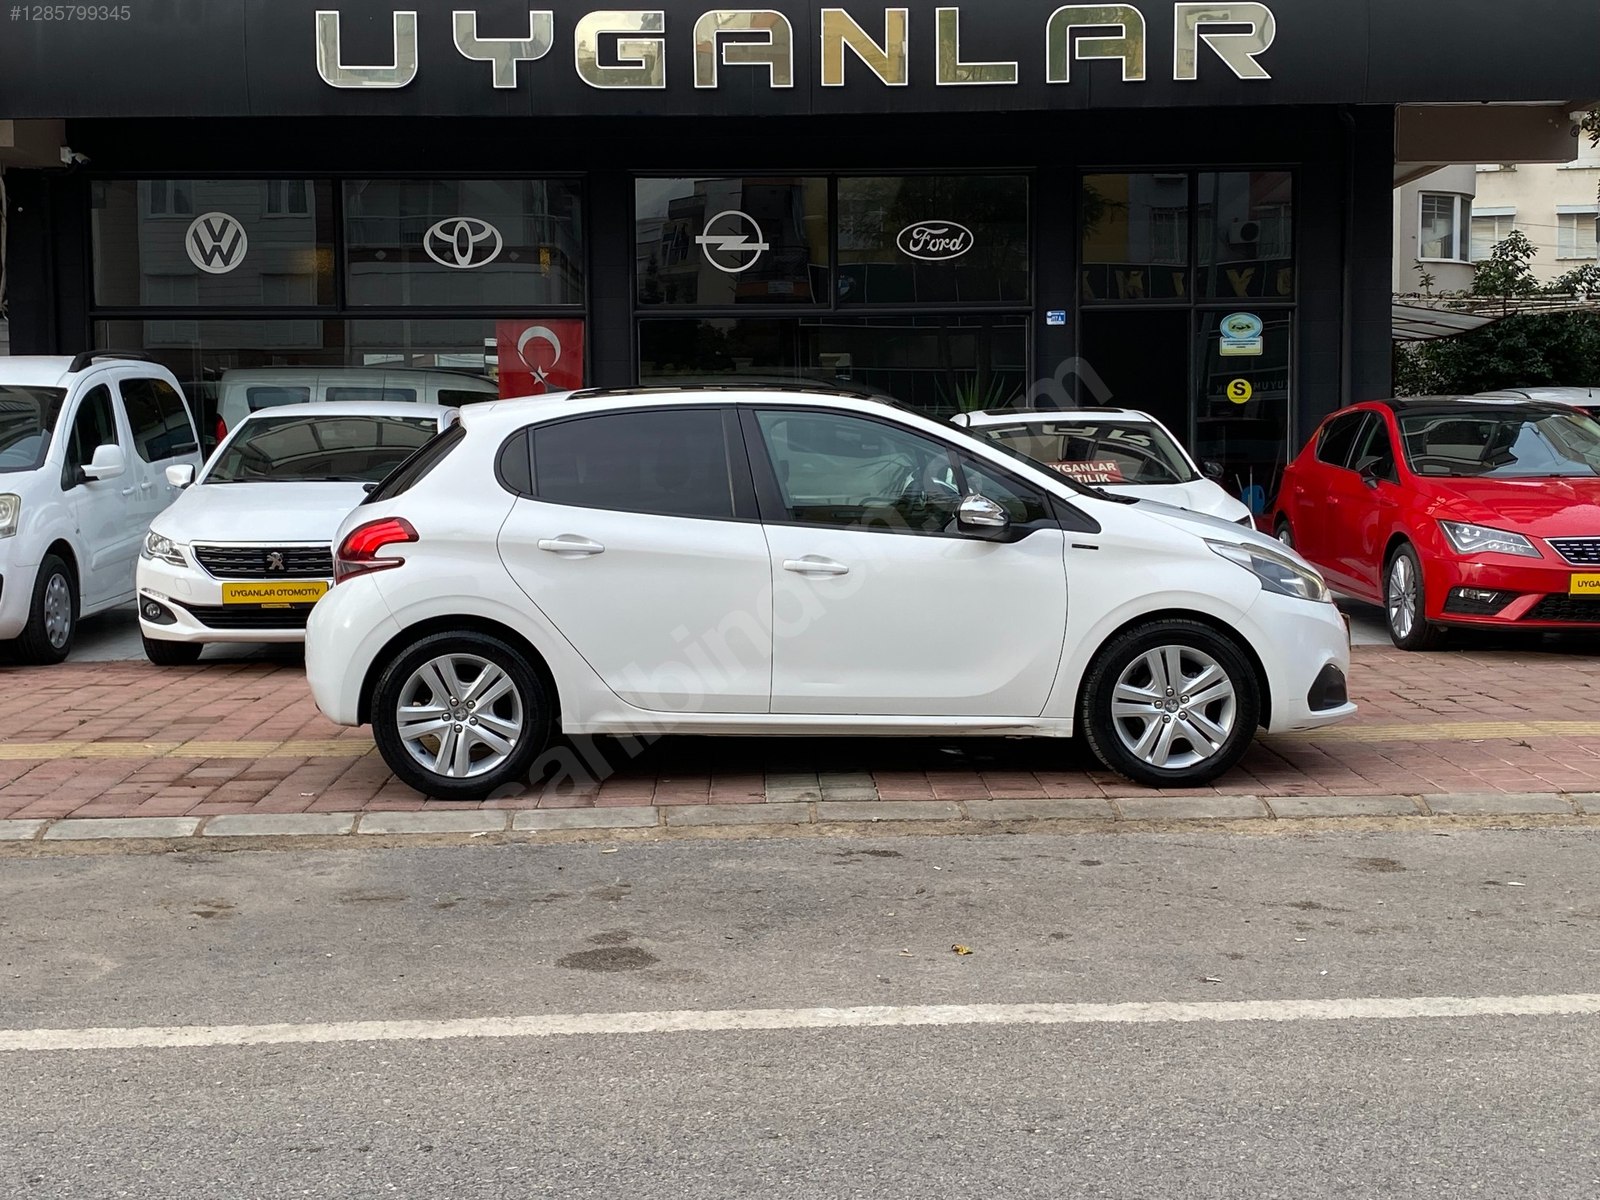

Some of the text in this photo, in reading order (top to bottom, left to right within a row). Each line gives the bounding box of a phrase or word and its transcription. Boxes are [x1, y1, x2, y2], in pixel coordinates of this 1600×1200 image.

[315, 2, 1276, 90] UYGANLAR
[909, 226, 966, 252] Ford
[1233, 381, 1246, 396] S
[1049, 462, 1117, 473] YGANLAR
[1069, 473, 1111, 483] TILIK
[230, 589, 275, 597] UYGANLAR
